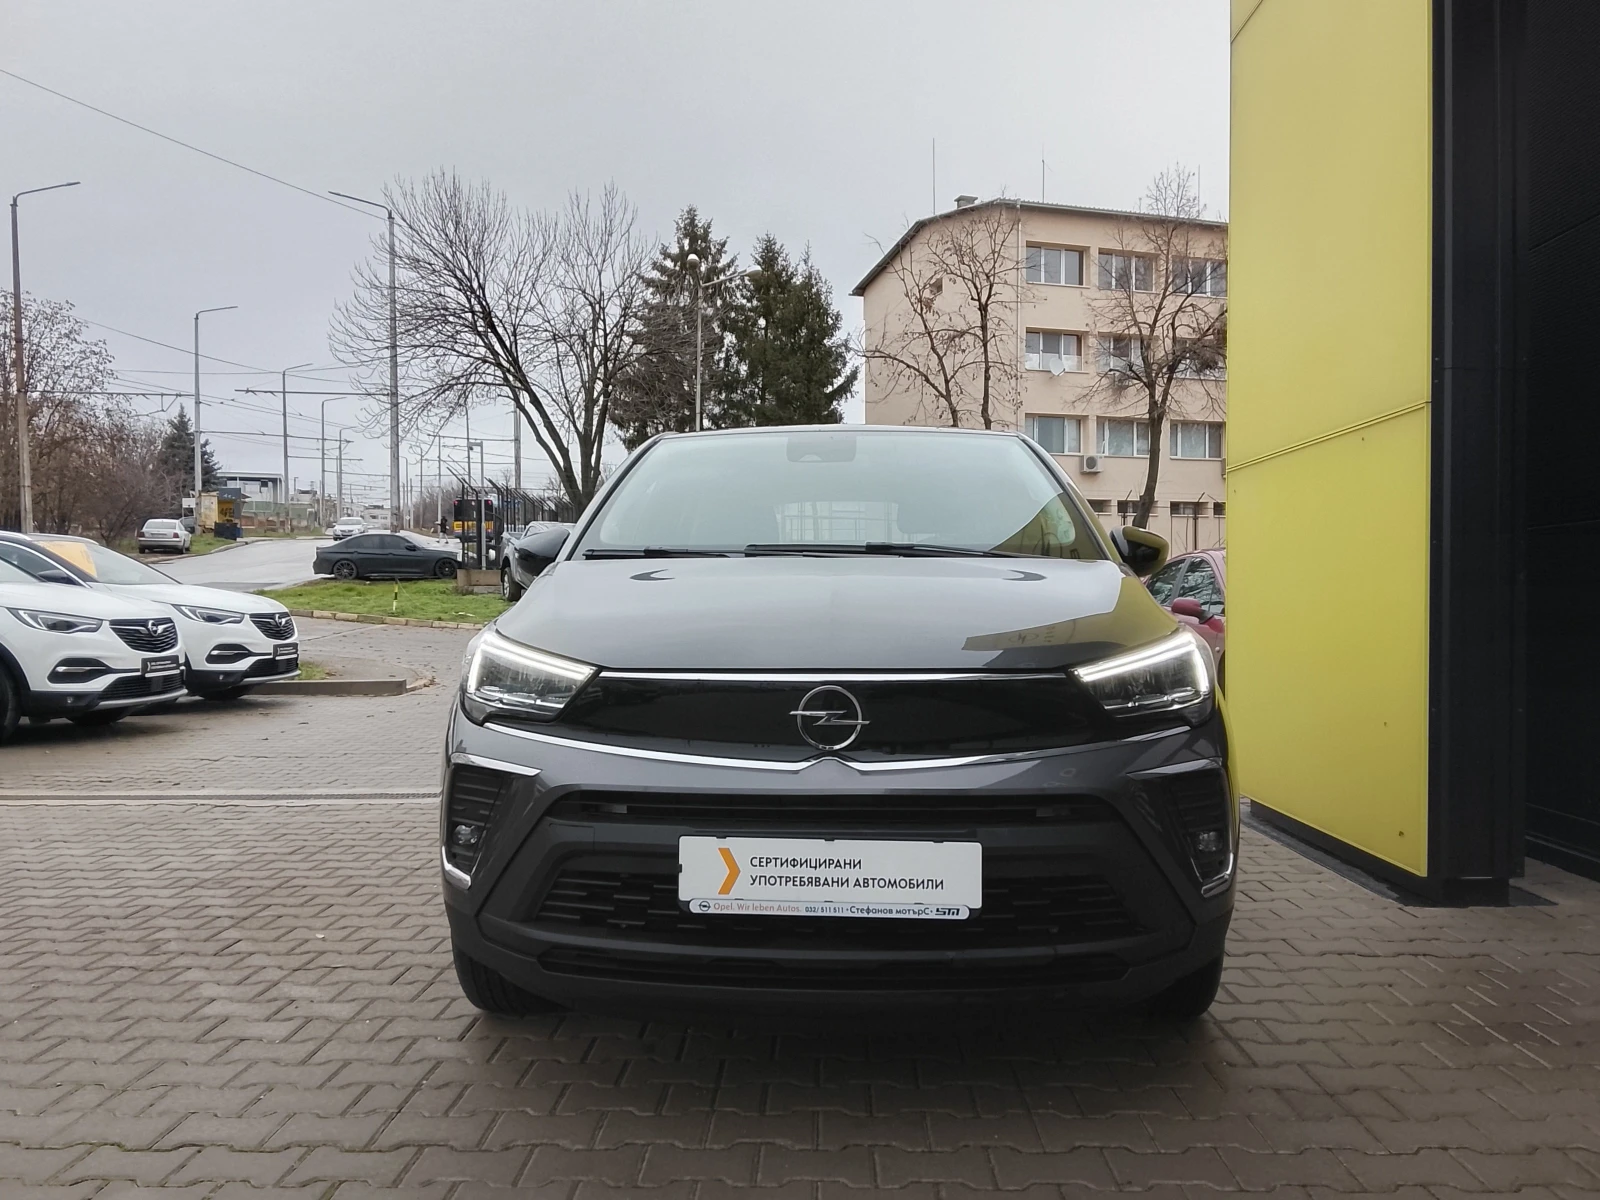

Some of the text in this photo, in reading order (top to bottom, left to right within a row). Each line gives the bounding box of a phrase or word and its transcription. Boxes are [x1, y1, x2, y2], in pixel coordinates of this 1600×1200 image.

[750, 856, 862, 870] СЕРТИФИЦИРАНИ
[750, 875, 944, 890] УПОТРЕБЯВАНИ АВТОМОБИЛИ
[737, 902, 750, 911] Wir
[752, 903, 775, 912] leben
